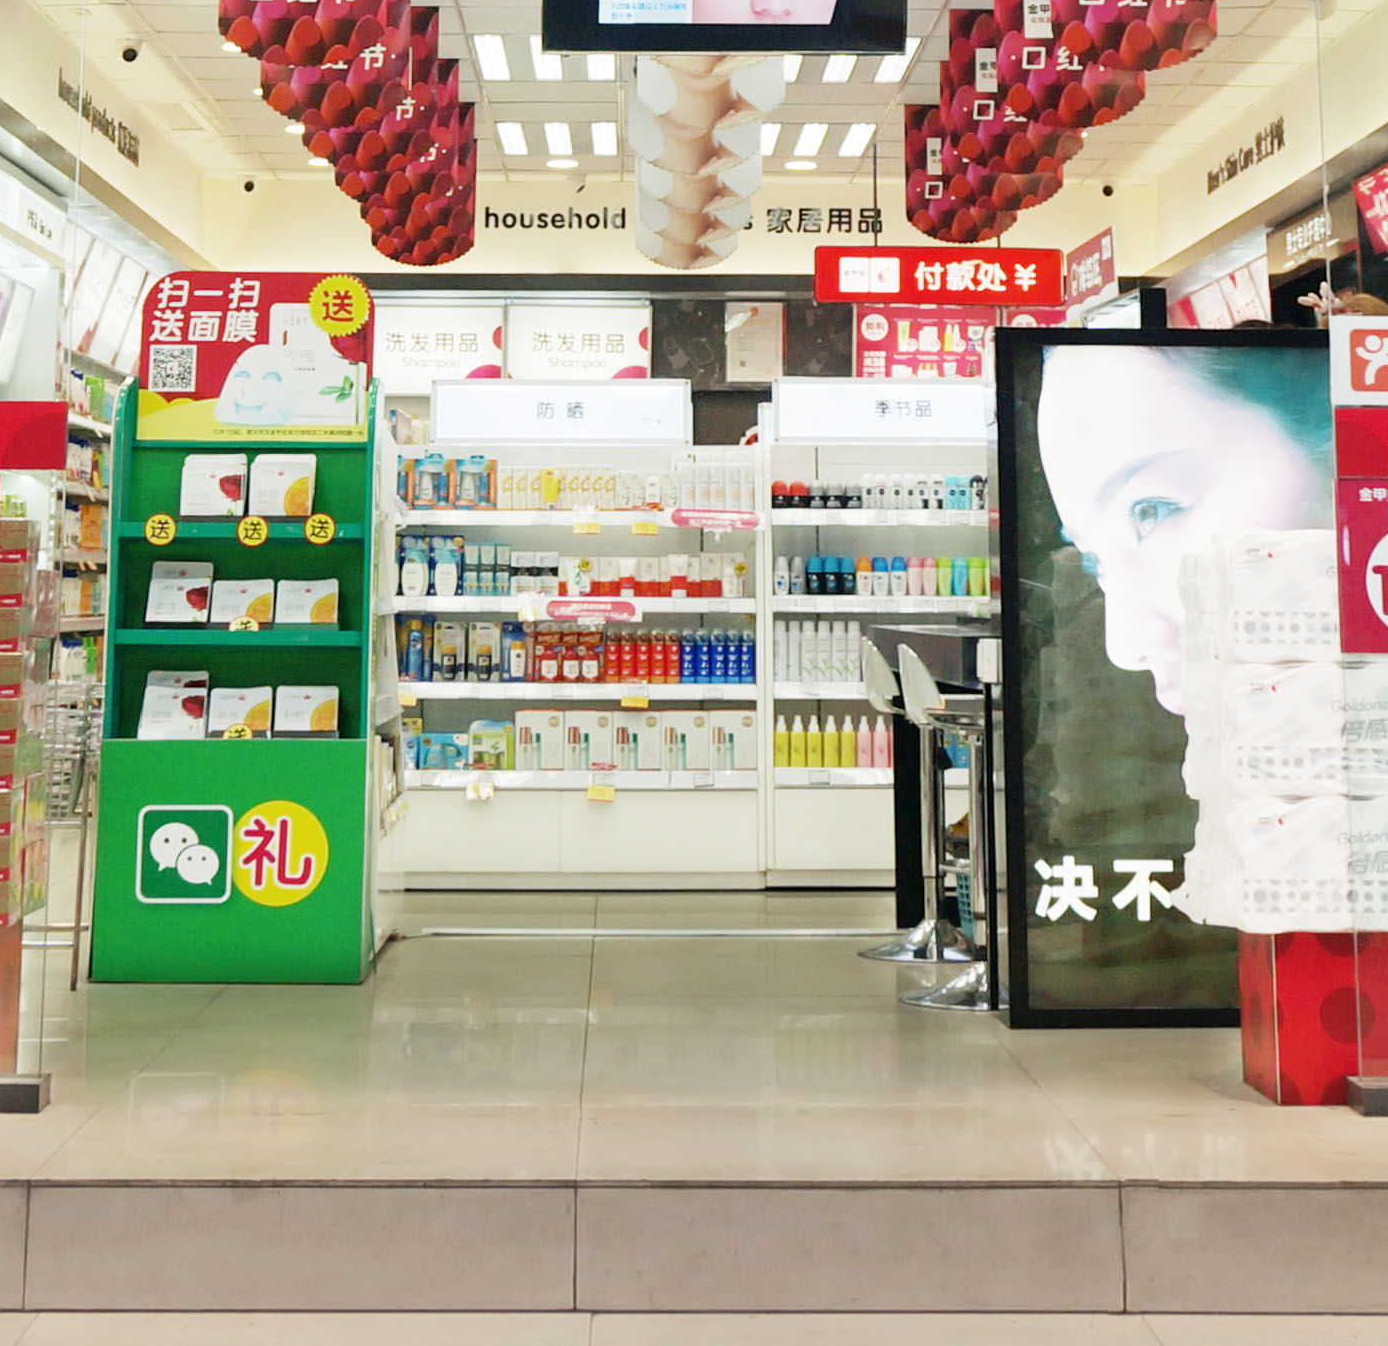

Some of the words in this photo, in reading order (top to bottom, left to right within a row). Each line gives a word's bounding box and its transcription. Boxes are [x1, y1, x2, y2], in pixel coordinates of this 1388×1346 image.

[485, 206, 627, 229] household
[766, 207, 884, 234] 家居用品
[915, 260, 1008, 293] 付款处
[158, 277, 261, 309] 扫一扫
[322, 290, 355, 322] 送
[149, 309, 259, 343] 送面膜
[385, 331, 479, 353] 洗发用品
[532, 331, 625, 354] 洗发用品
[150, 519, 171, 539] 送
[242, 521, 262, 540] 送
[310, 518, 329, 539] 送
[242, 818, 312, 887] 礼
[1033, 855, 1173, 922] 决不
